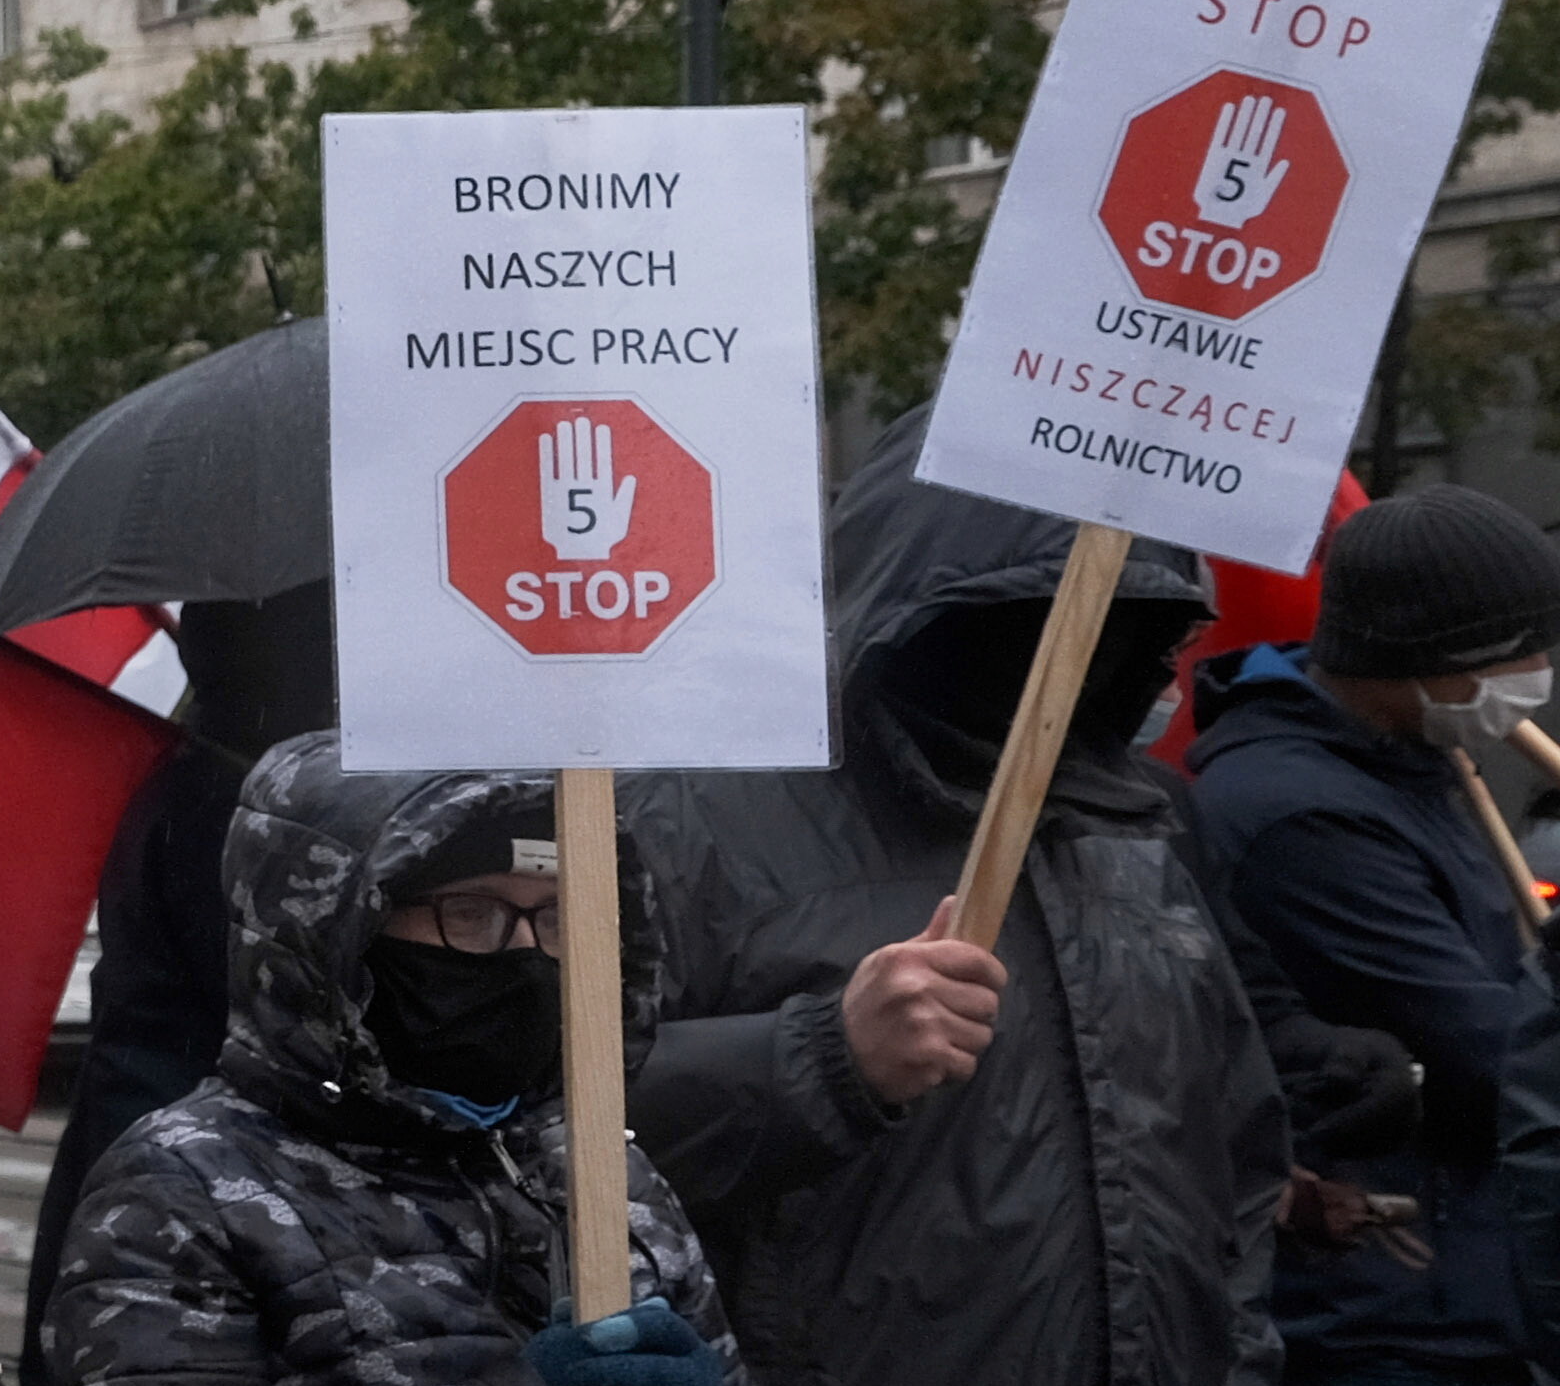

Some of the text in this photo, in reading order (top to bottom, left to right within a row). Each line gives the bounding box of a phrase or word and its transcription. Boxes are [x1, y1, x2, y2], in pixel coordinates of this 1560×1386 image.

[454, 172, 680, 213] BRONIMY
[1214, 157, 1251, 203] 5
[463, 250, 676, 290] NASZYCH
[1137, 220, 1281, 291] STOP
[406, 328, 739, 369] MIEJSC PRACY
[1095, 299, 1263, 371] USTAWIE
[1012, 347, 1297, 446] NISZCZĄCEJ
[1030, 416, 1243, 496] ROLNICTWO
[566, 488, 597, 534] 5
[505, 570, 670, 621] STOP
